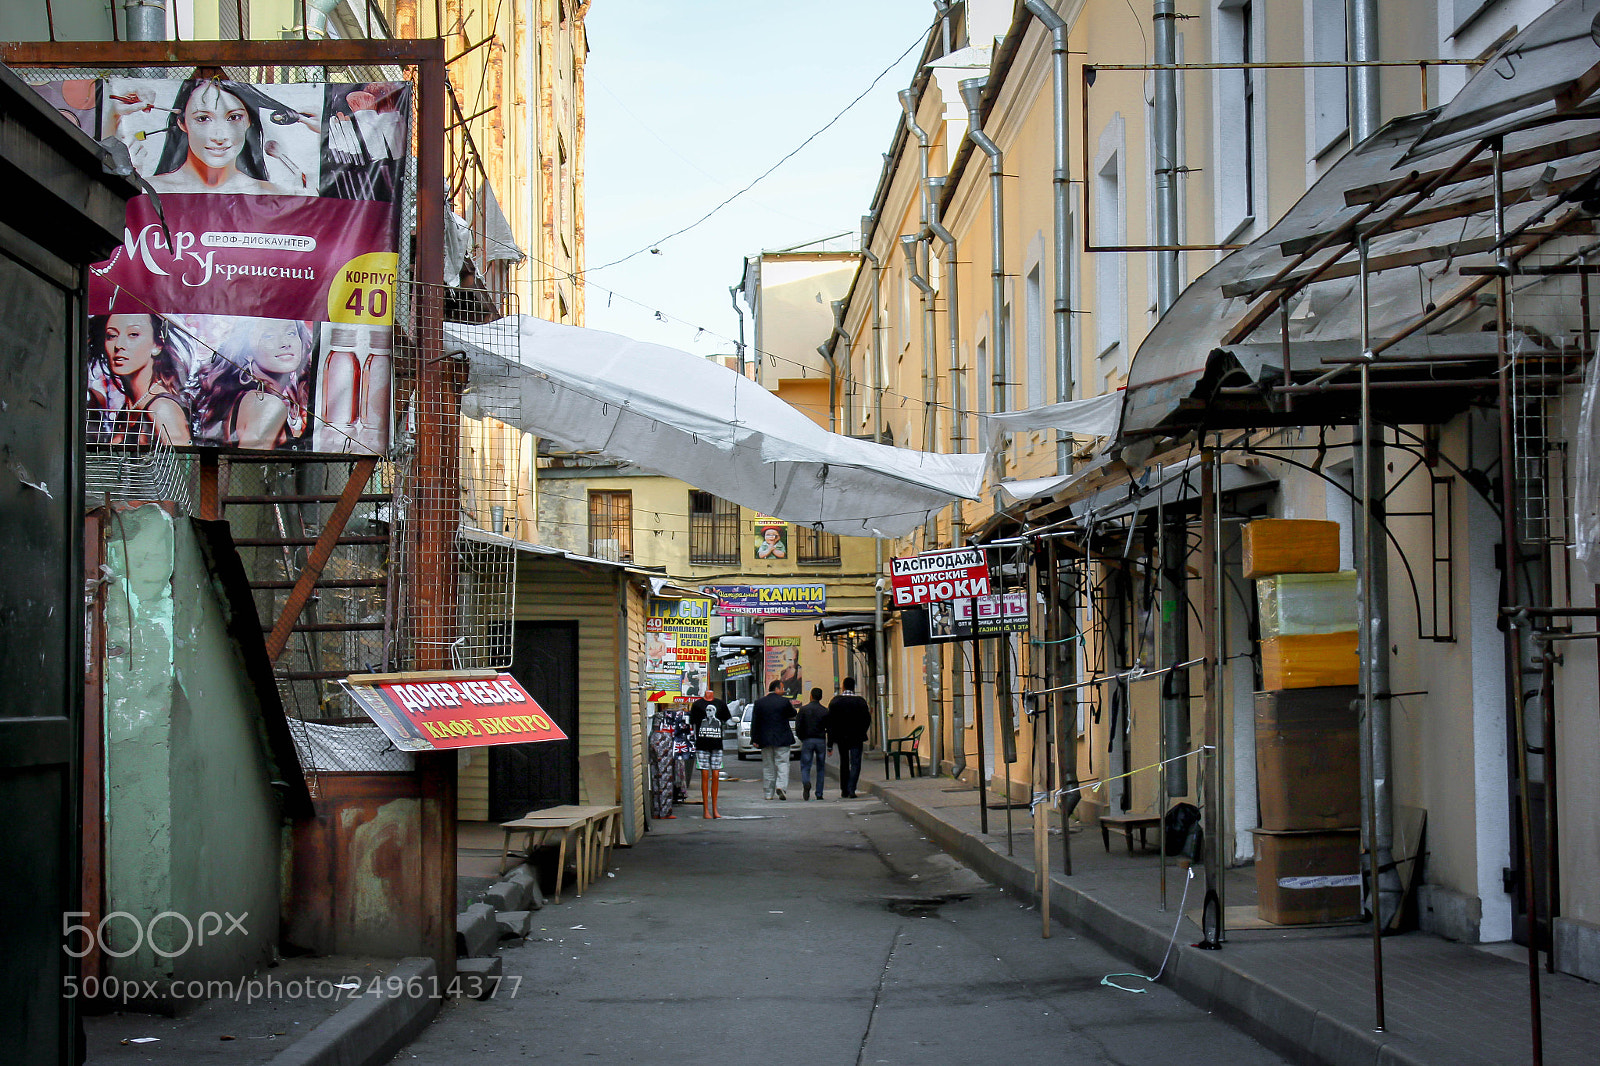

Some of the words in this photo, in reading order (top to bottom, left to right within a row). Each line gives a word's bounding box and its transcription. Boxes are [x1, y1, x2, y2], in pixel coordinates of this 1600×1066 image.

[207, 234, 310, 249] ПРОФ-ДИСКАУНТЕР
[124, 224, 195, 276] Мир
[181, 250, 315, 287] Украшений
[345, 270, 395, 285] КОРПУС
[345, 288, 388, 318] 40
[894, 550, 985, 573] РАСПРОДАЖА
[911, 569, 968, 584] МУЖСКИЕ
[759, 587, 823, 602] КАМНИ
[896, 577, 989, 604] БРЮКИ
[649, 600, 708, 619] ТРУСЫ
[763, 607, 789, 615] ЦЕНЫ
[963, 601, 1028, 617] БЕЛЬ
[647, 618, 662, 627] 40
[663, 618, 708, 626] МУЖСКИЕ
[681, 639, 708, 647] БЕЛЬЯ
[666, 647, 707, 655] НОСОВЫЕ
[391, 680, 527, 714] ДОНЕР-КЕБАБ
[422, 718, 482, 739] КАФЕ
[476, 714, 551, 736] БИСТРО
